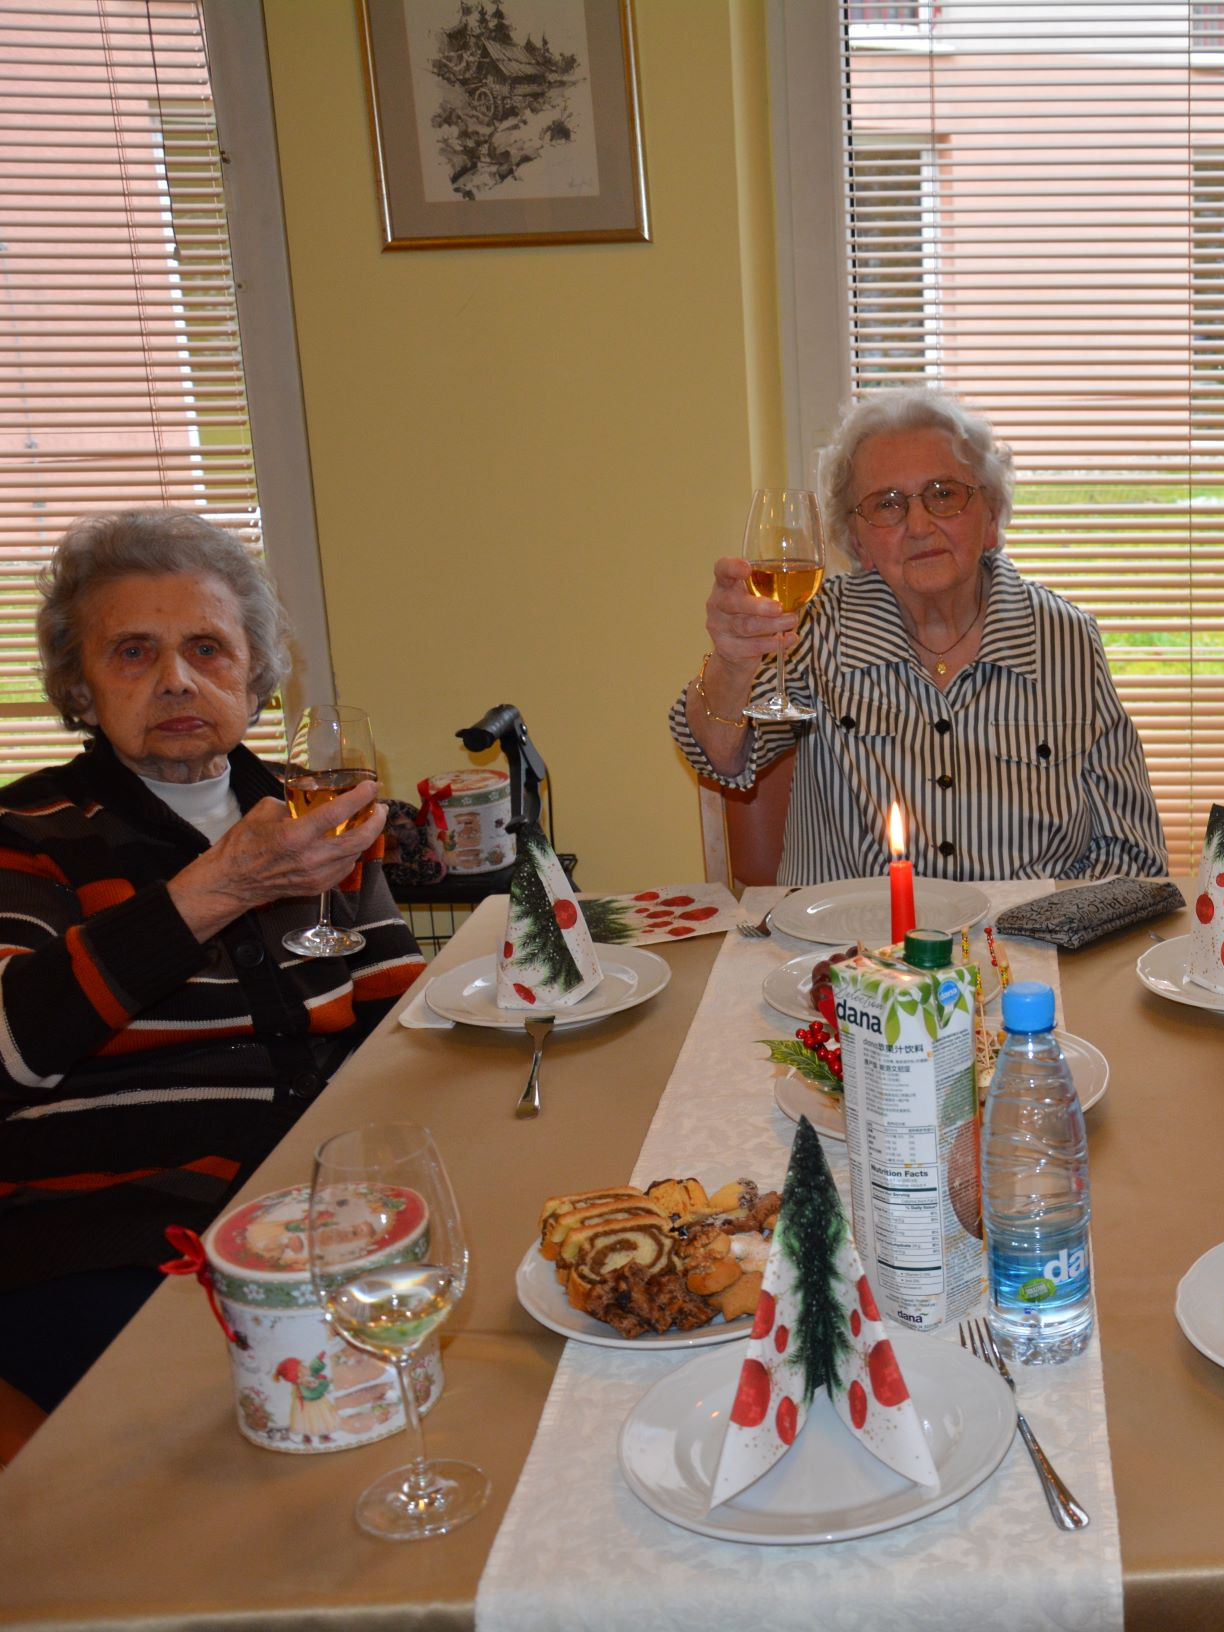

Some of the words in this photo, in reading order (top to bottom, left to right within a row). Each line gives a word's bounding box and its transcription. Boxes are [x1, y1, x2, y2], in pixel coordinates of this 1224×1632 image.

[836, 999, 882, 1035] dana
[871, 1163, 902, 1177] Nutrition
[897, 1310, 923, 1323] dana
